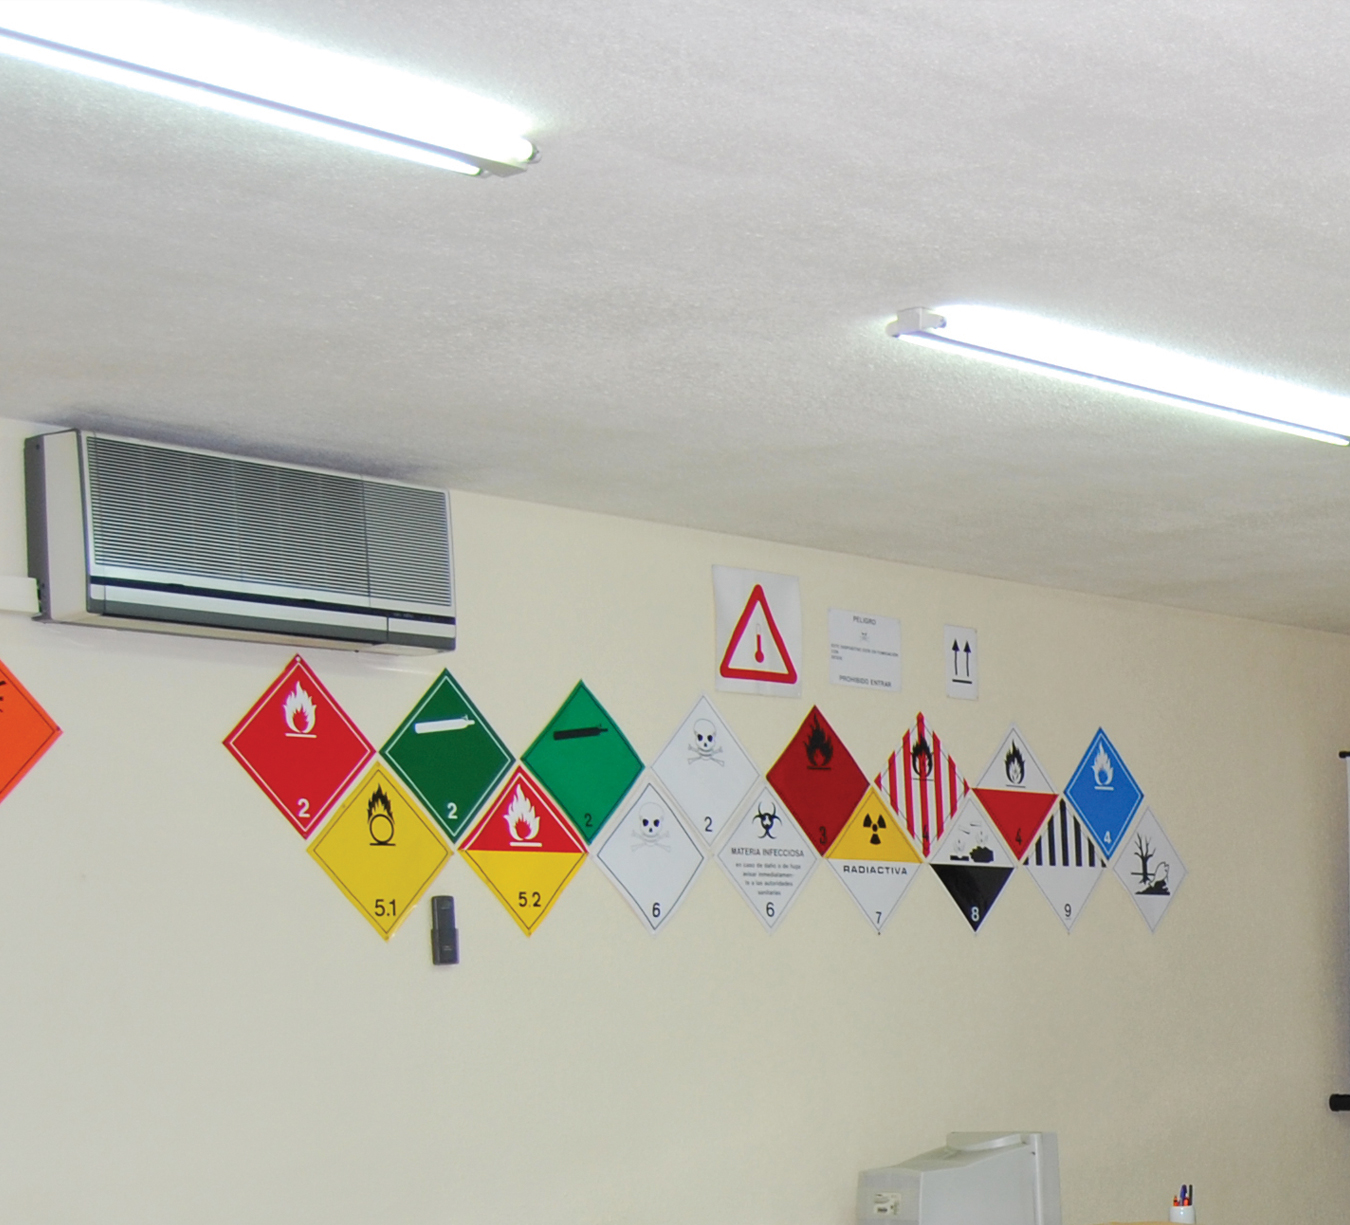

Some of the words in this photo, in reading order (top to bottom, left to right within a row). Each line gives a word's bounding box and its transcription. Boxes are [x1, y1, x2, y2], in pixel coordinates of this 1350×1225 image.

[853, 616, 876, 625] PELIGRO
[839, 675, 869, 684] PROHIBIDO
[870, 679, 891, 687] ENTRAR
[297, 798, 311, 818] 2
[447, 802, 458, 819] 2
[583, 812, 594, 828] 2
[703, 815, 714, 833] 2
[819, 826, 828, 845] 3
[1015, 828, 1023, 846] 4
[1103, 831, 1112, 845] 4
[731, 847, 761, 856] MATERIA
[762, 848, 804, 857] INFECCIOSA
[843, 865, 908, 875] RADIACTIVA
[374, 898, 397, 917] 5.1
[652, 902, 661, 918] 6
[765, 901, 776, 918] 6
[970, 906, 980, 922] 8
[1063, 903, 1072, 918] 9
[875, 911, 883, 925] 7
